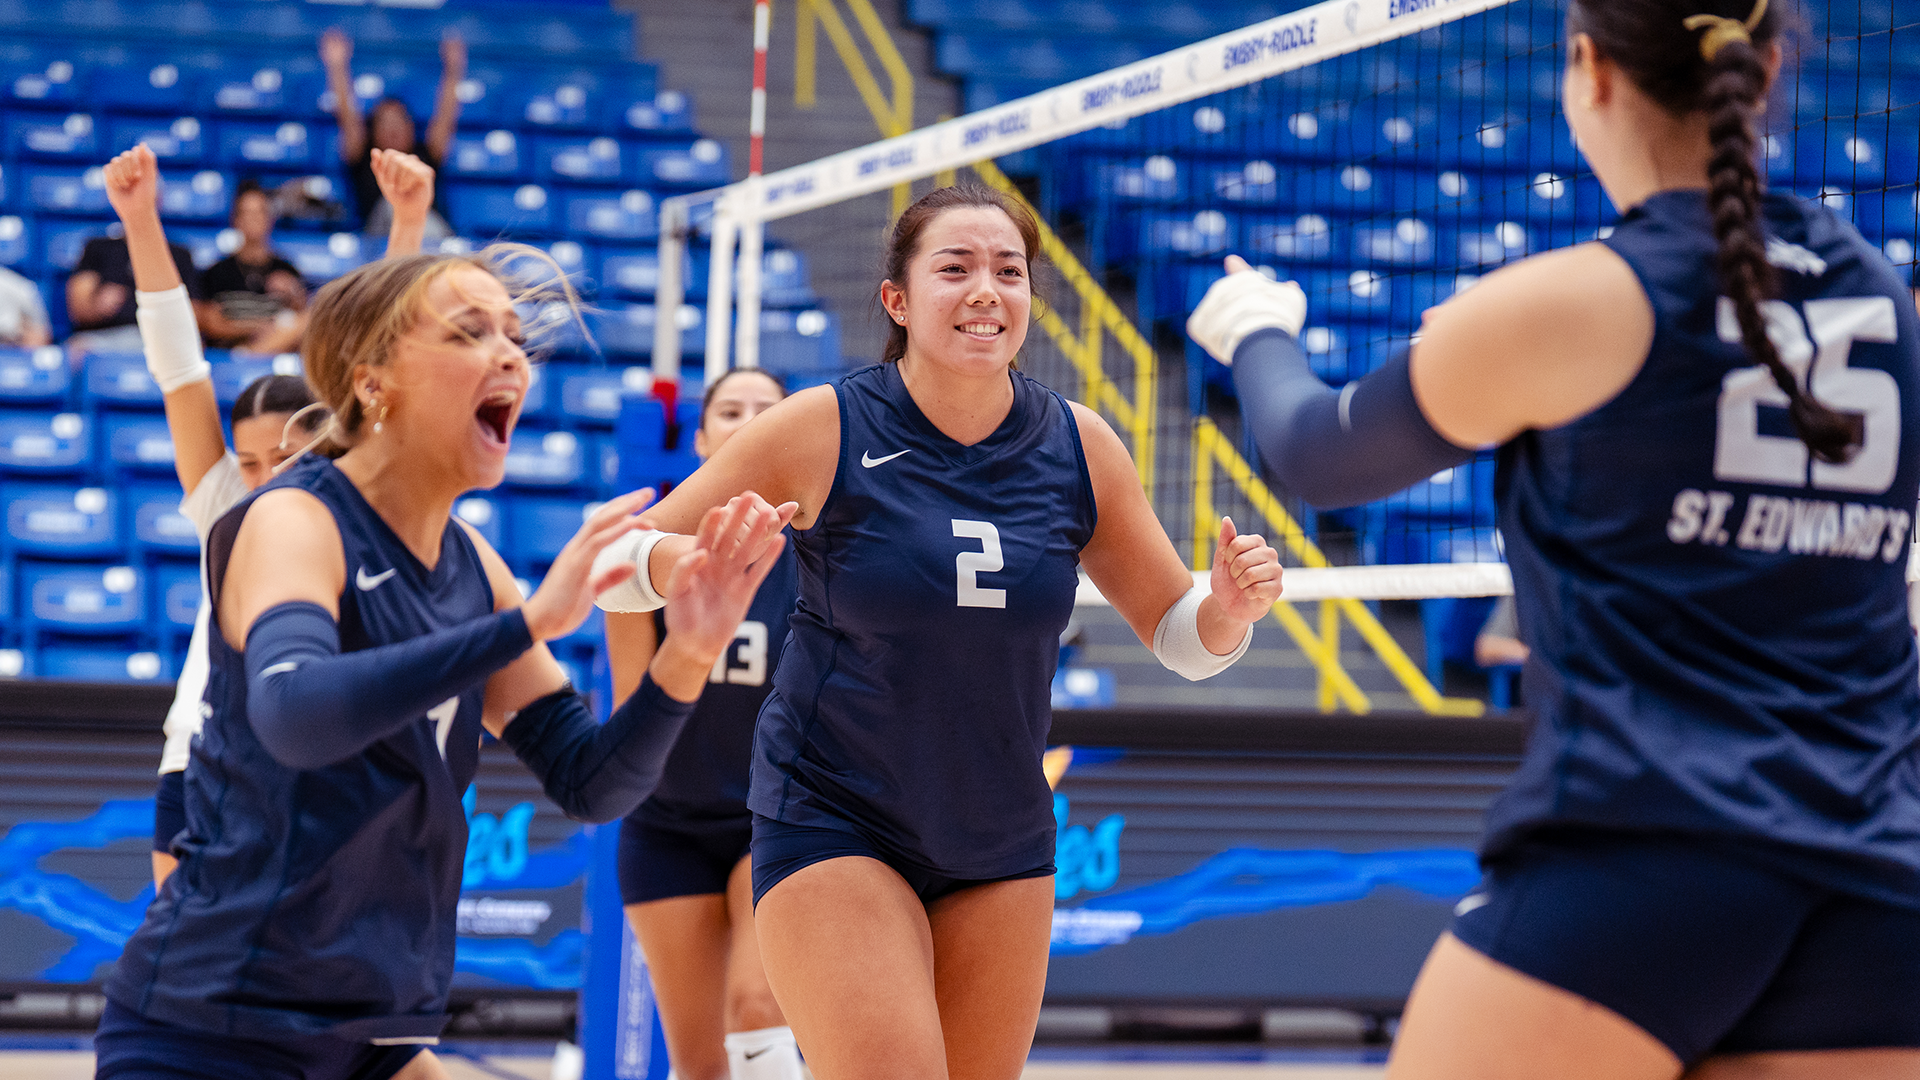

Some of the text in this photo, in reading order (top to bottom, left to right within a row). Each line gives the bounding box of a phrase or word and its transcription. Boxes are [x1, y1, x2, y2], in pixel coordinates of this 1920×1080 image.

[1712, 296, 1900, 495] 25
[951, 518, 1007, 609] 2
[1666, 488, 1910, 563] ST. EDWARD'S
